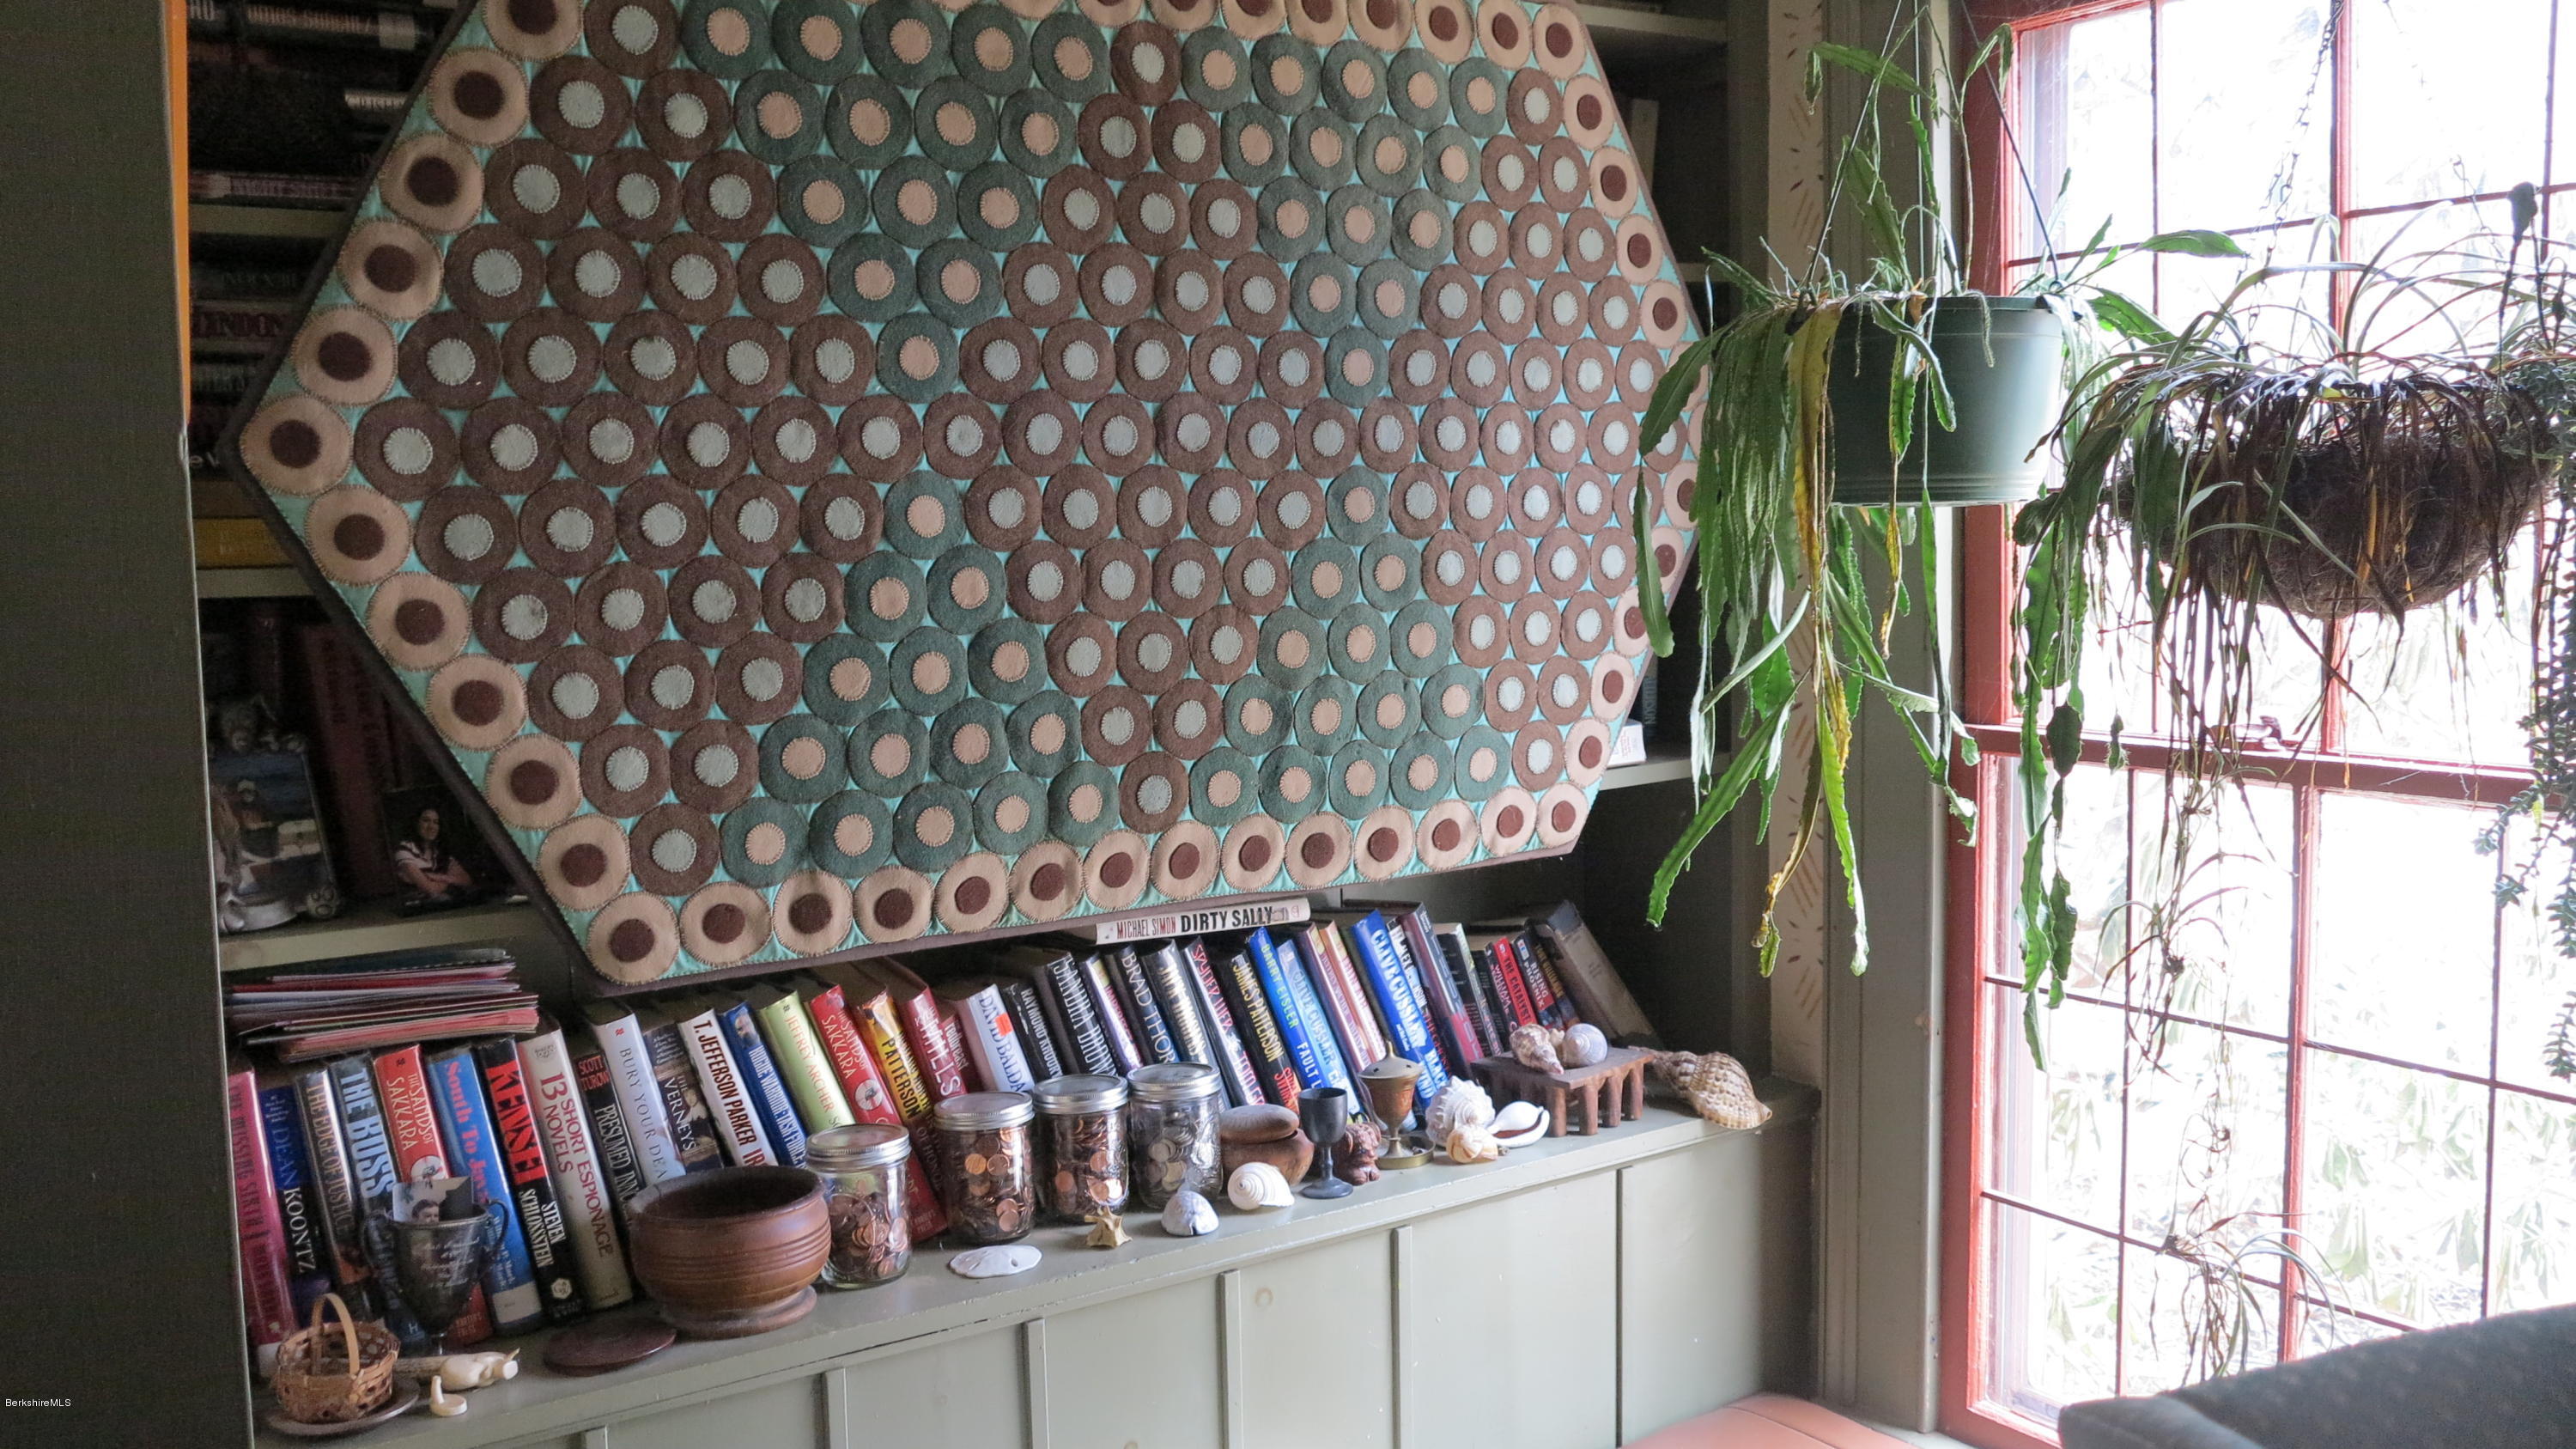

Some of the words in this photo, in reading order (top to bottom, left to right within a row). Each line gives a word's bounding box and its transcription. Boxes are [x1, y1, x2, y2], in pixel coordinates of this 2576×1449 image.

[1116, 916, 1150, 940] MICHAEL
[1151, 916, 1176, 935] SIMON
[1181, 910, 1228, 933] DIRTY
[1231, 905, 1273, 928] SALLY
[1192, 944, 1221, 998] SPYDER
[1371, 928, 1400, 980] CLIVE
[1530, 961, 1549, 998] RISING
[1053, 957, 1096, 1030] SANDRA
[1121, 951, 1153, 1008] BRAD
[1143, 1005, 1176, 1064] THOR
[1232, 962, 1260, 1002] JAMES
[1248, 995, 1285, 1062] PATTERSON
[1523, 961, 1545, 1008] PHOENIX
[693, 1019, 713, 1035] T.
[840, 1020, 866, 1065] SANDS
[1020, 988, 1046, 1041] RAYMOND
[1275, 985, 1300, 1029] EISLER
[1296, 1041, 1319, 1078] FAULT
[1308, 1005, 1337, 1065] CUSSLER
[578, 1054, 605, 1075] SCOTT
[698, 1034, 740, 1106] JEFFERSON
[747, 1044, 775, 1078] ROGUE
[785, 1015, 812, 1061] JEFFREY
[806, 1064, 835, 1113] ARCHER
[822, 1014, 857, 1079] SAKKARA
[945, 1021, 969, 1071] redbreast
[307, 1084, 328, 1116] THE
[340, 1067, 376, 1115] THE
[446, 1061, 472, 1123] South
[462, 1124, 479, 1154] To
[580, 1071, 611, 1092] TUROW
[881, 1036, 922, 1120] PATTERSON
[313, 1117, 340, 1155] EDGE
[386, 1076, 419, 1151] SAKKARA
[409, 1085, 435, 1137] SANDS
[485, 1059, 547, 1185] KENSEI
[544, 1105, 574, 1174] NOVELS
[593, 1103, 632, 1170] PRESUMED
[619, 1046, 643, 1088] BURY
[634, 1092, 656, 1141] YOUR
[649, 1143, 669, 1180] DEA
[664, 1075, 697, 1152] VERNEYS
[725, 1099, 757, 1147] PARKER
[271, 1127, 301, 1187] DEAN
[322, 1155, 344, 1176] OF
[345, 1114, 397, 1199] BOSS
[540, 1071, 568, 1100] 13
[561, 1099, 587, 1155] SHORT
[577, 1160, 613, 1258] ESPIONAGE
[283, 1186, 317, 1273] KOONTZ
[325, 1176, 355, 1235] JUSTICE
[541, 1200, 567, 1245] STEVEN
